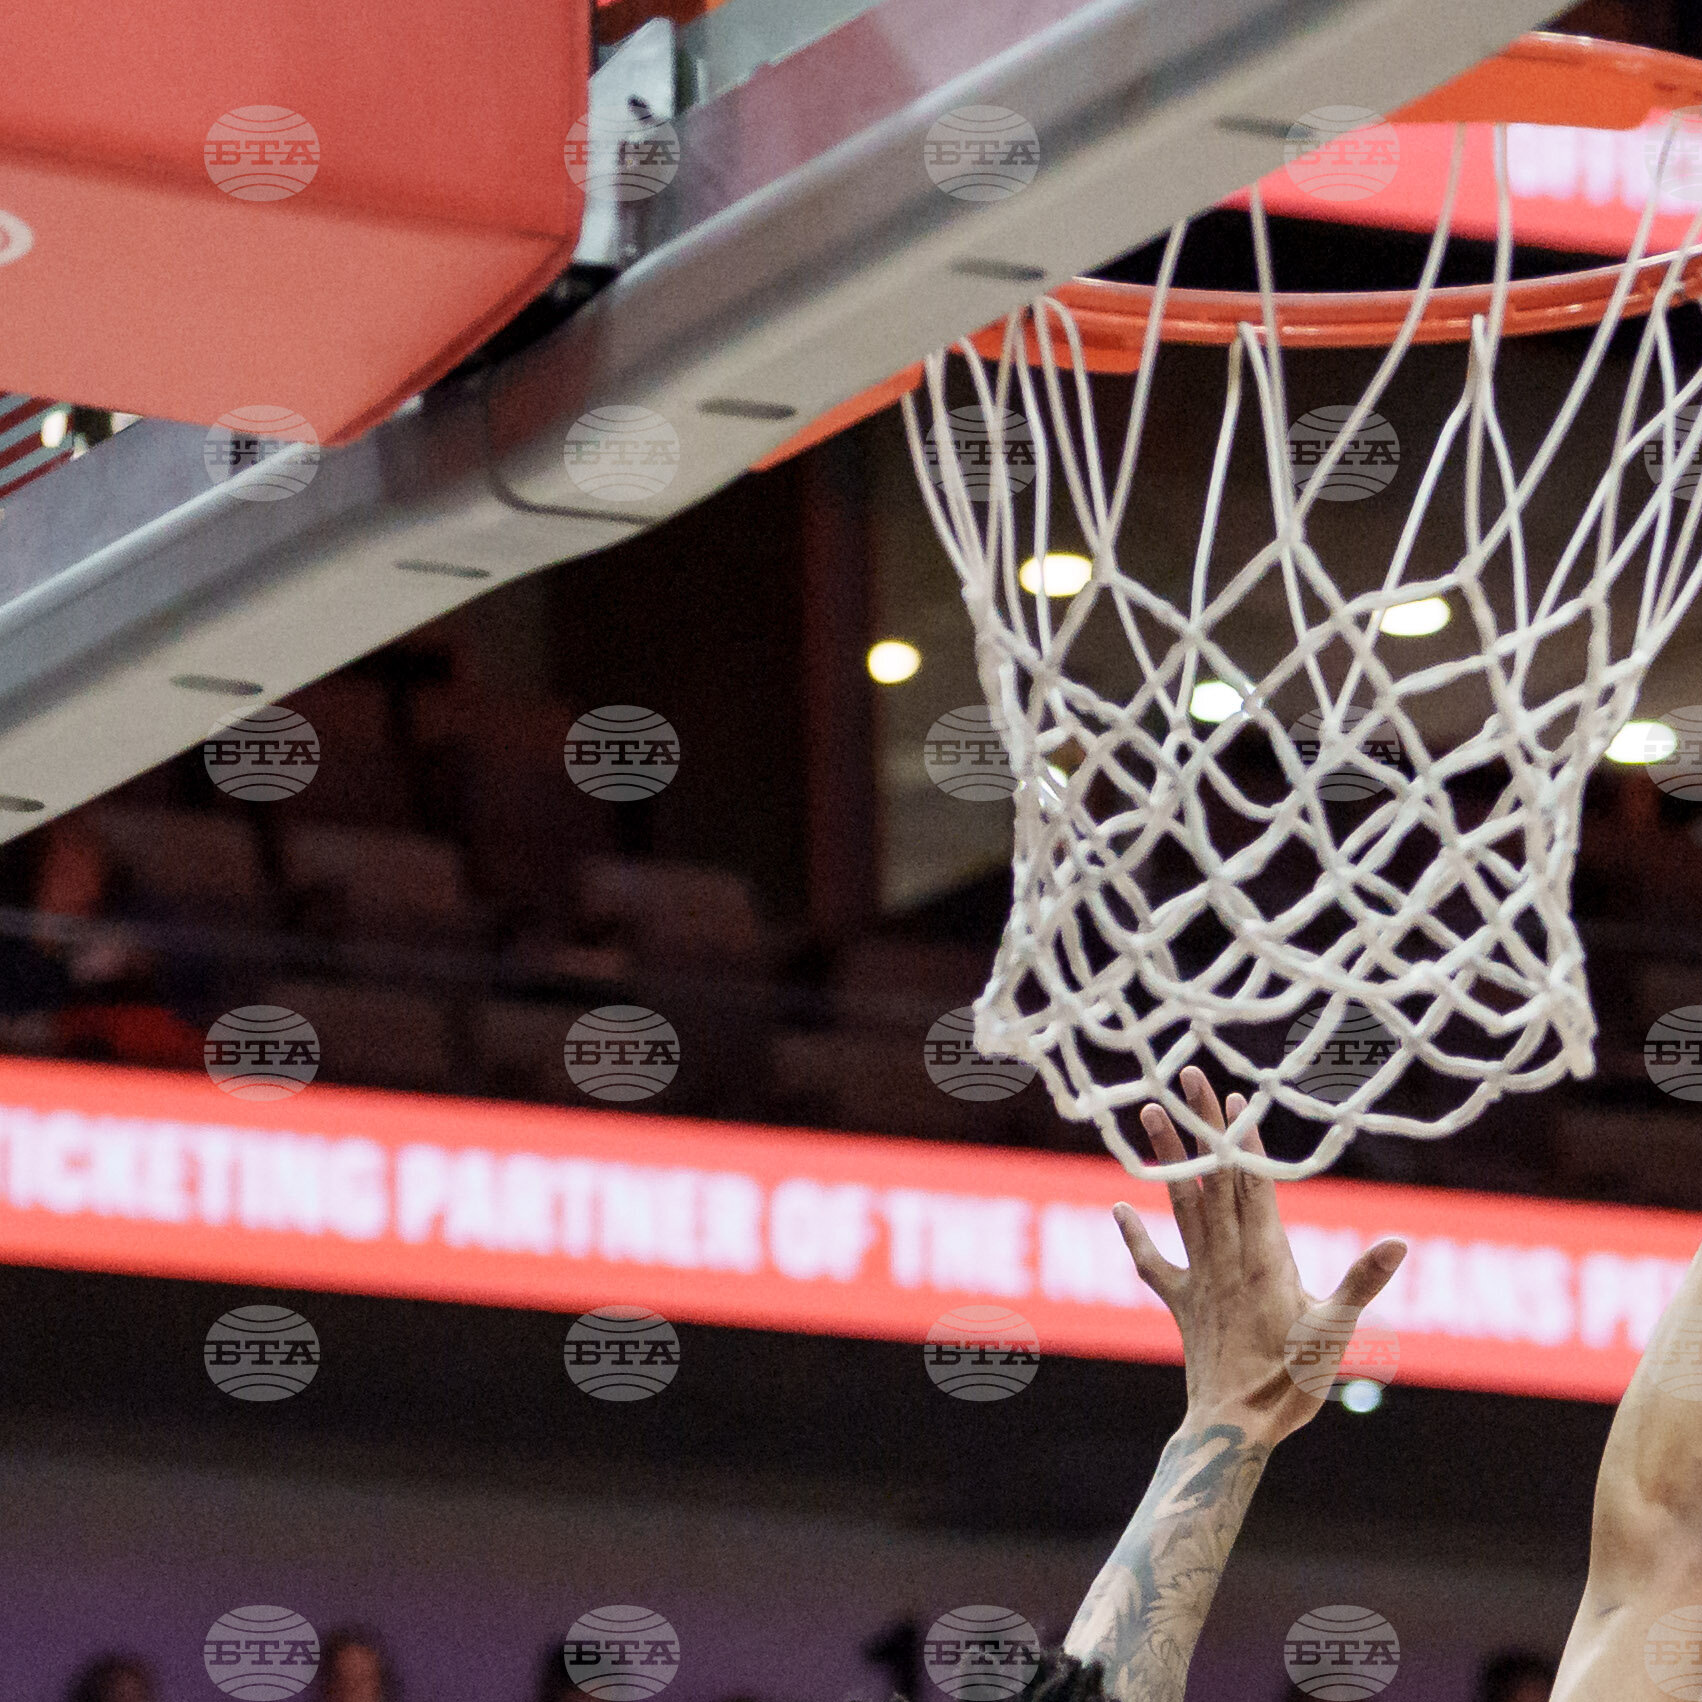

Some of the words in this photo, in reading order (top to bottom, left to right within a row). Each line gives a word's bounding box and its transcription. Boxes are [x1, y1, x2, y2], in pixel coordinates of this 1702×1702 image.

[395, 1142, 763, 1276] PARTNER
[769, 1176, 874, 1284] OF
[884, 1187, 1034, 1298] THE
